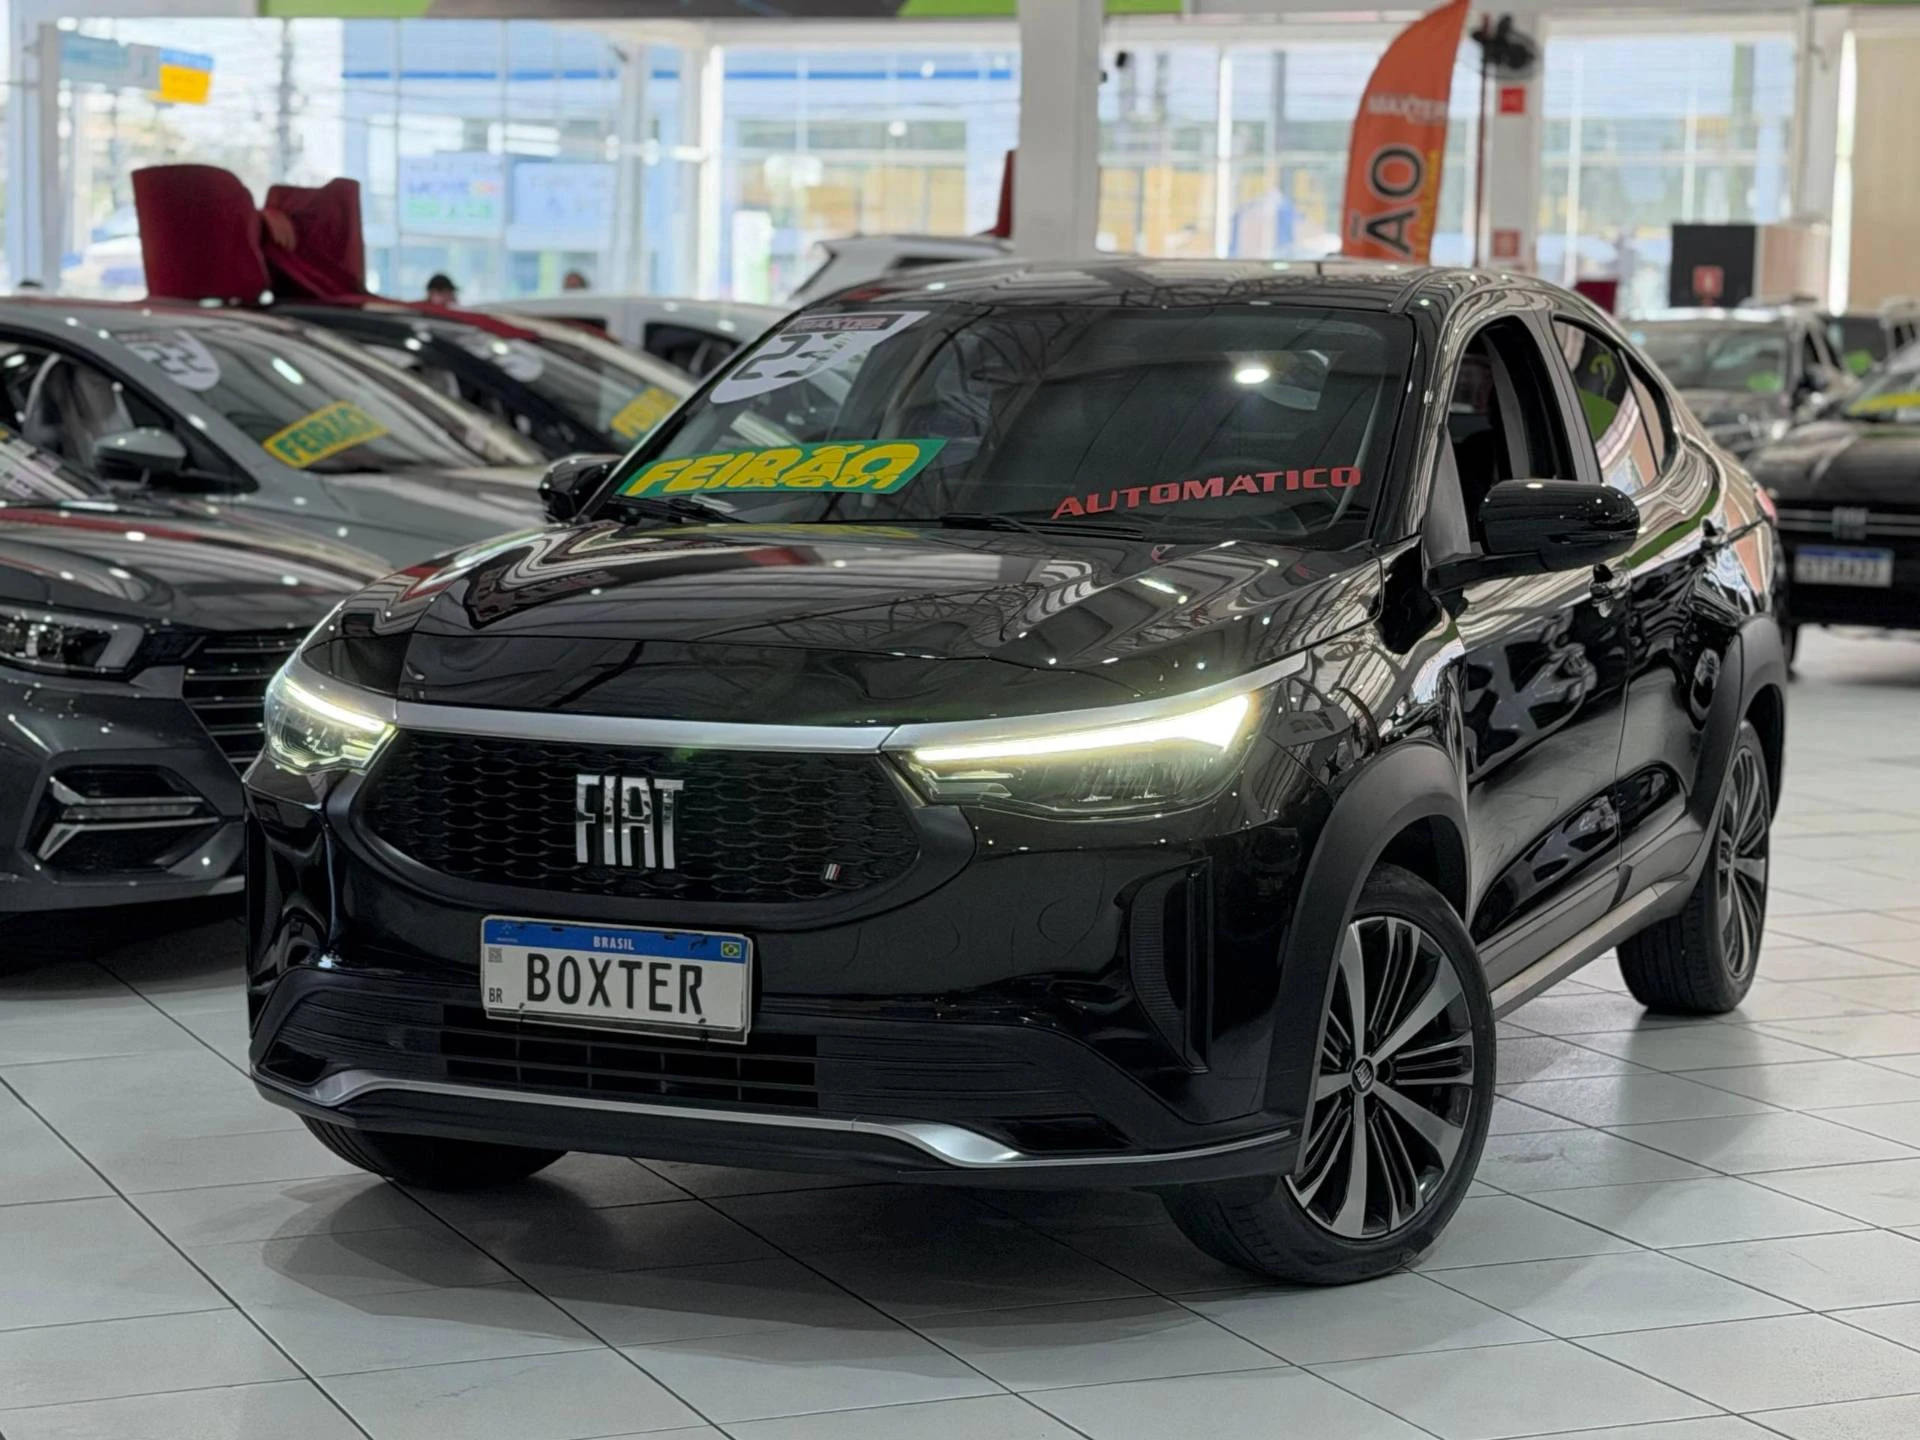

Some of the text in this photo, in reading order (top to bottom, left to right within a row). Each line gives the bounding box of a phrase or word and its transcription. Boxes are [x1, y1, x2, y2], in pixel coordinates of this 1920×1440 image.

[625, 444, 920, 496] FEIRÃO
[576, 774, 684, 870] FIAT
[593, 936, 634, 950] BRASIL
[488, 988, 503, 1003] BR
[527, 953, 703, 1015] BOXTER
